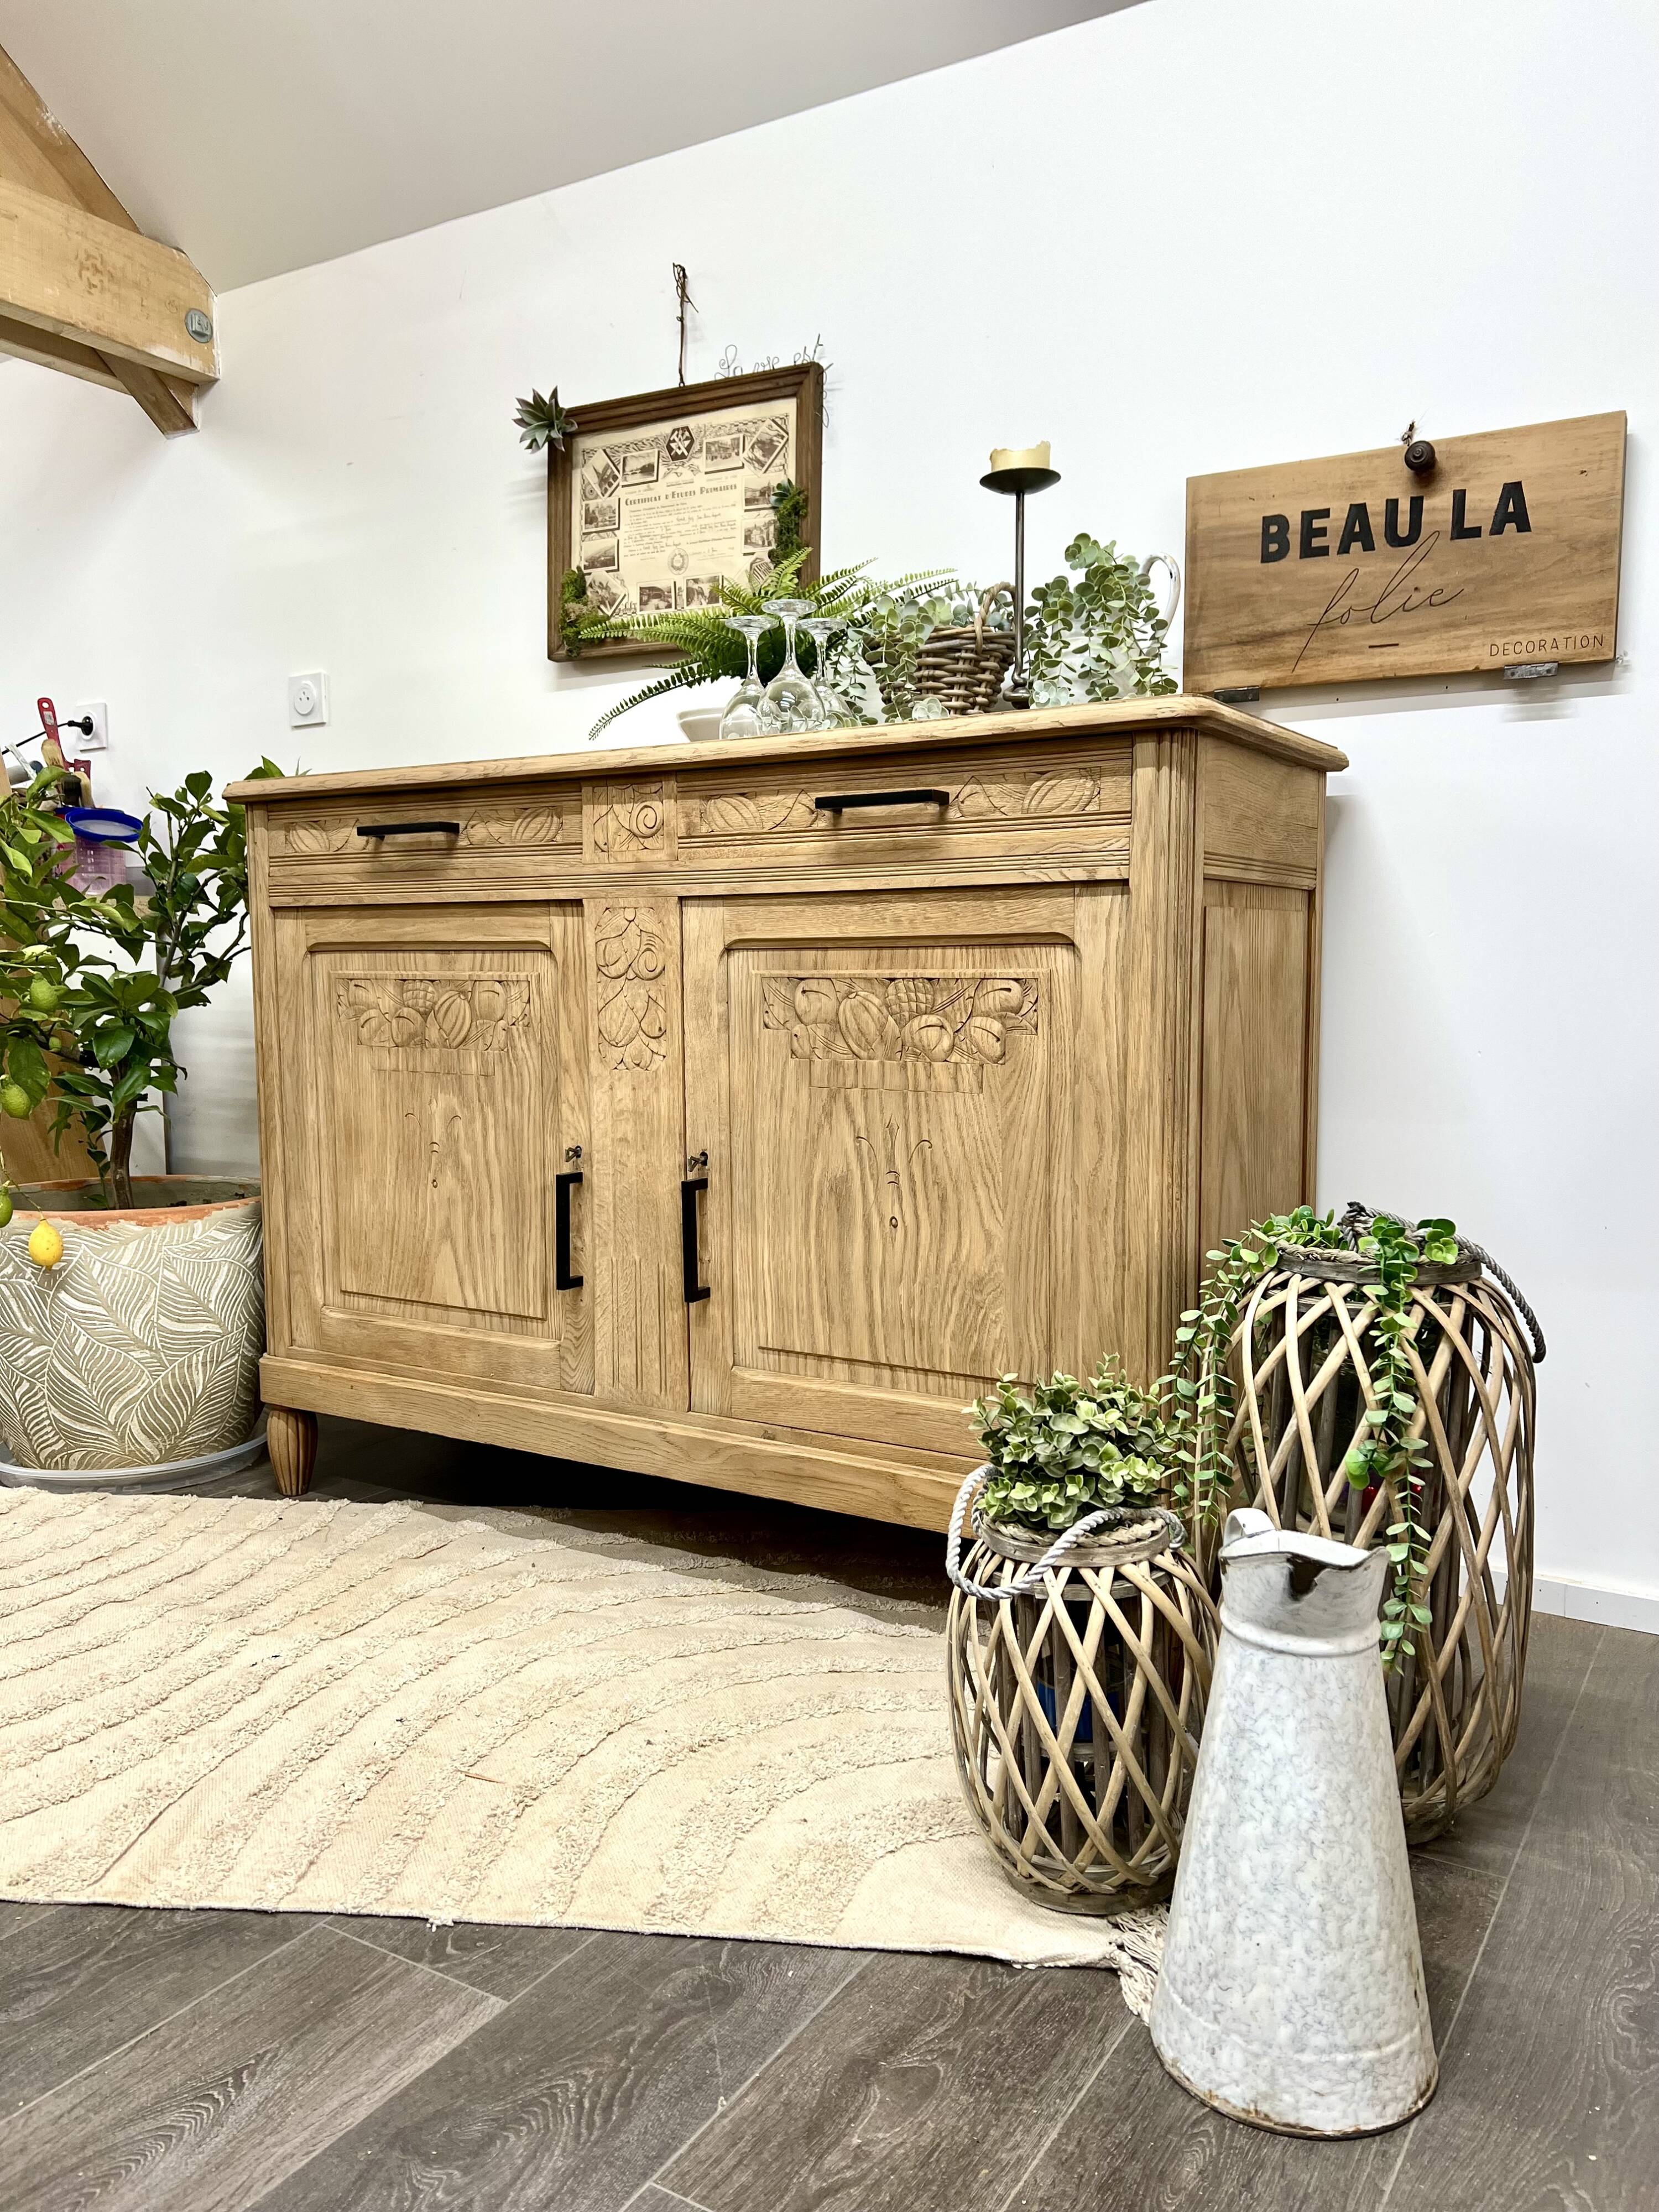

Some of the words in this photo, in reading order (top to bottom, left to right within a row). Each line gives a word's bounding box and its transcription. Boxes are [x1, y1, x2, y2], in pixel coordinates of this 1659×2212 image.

[1260, 495, 1425, 563] BEAU
[1450, 481, 1532, 541] LA
[1291, 530, 1465, 674] folie
[1489, 634, 1604, 657] DECORATION
